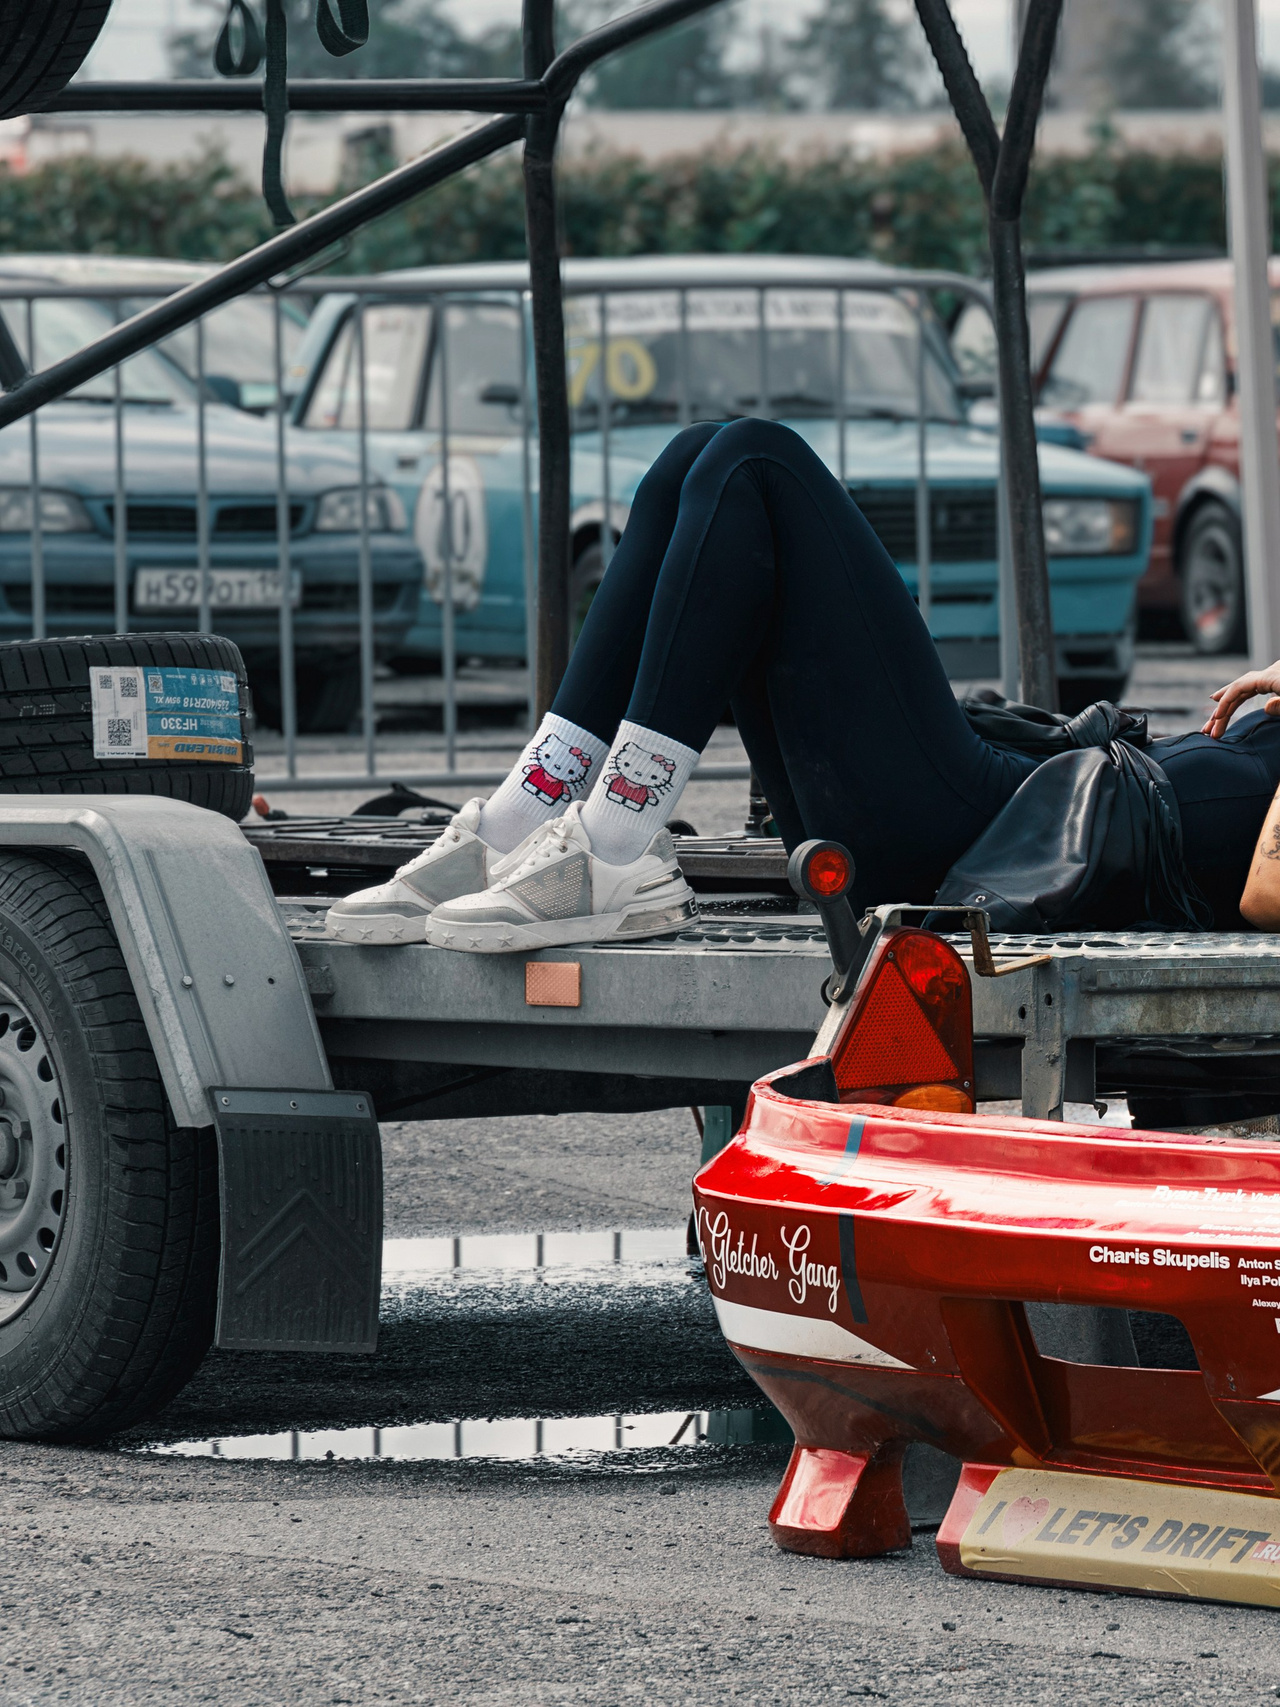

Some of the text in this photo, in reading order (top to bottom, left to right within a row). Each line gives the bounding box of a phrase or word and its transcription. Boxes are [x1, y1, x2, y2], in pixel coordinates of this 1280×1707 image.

[568, 338, 657, 408] 70
[160, 717, 198, 731] HF330
[705, 1211, 779, 1290] Gletcher
[780, 1224, 841, 1314] Gang
[1089, 1246, 1150, 1265] Charis
[1153, 1248, 1231, 1271] Skupelis
[1237, 1258, 1273, 1270] Anton
[1240, 1274, 1261, 1287] Ilya
[1252, 1299, 1280, 1310] Alexey
[977, 1501, 1007, 1535] I
[1035, 1507, 1150, 1551] LET'S
